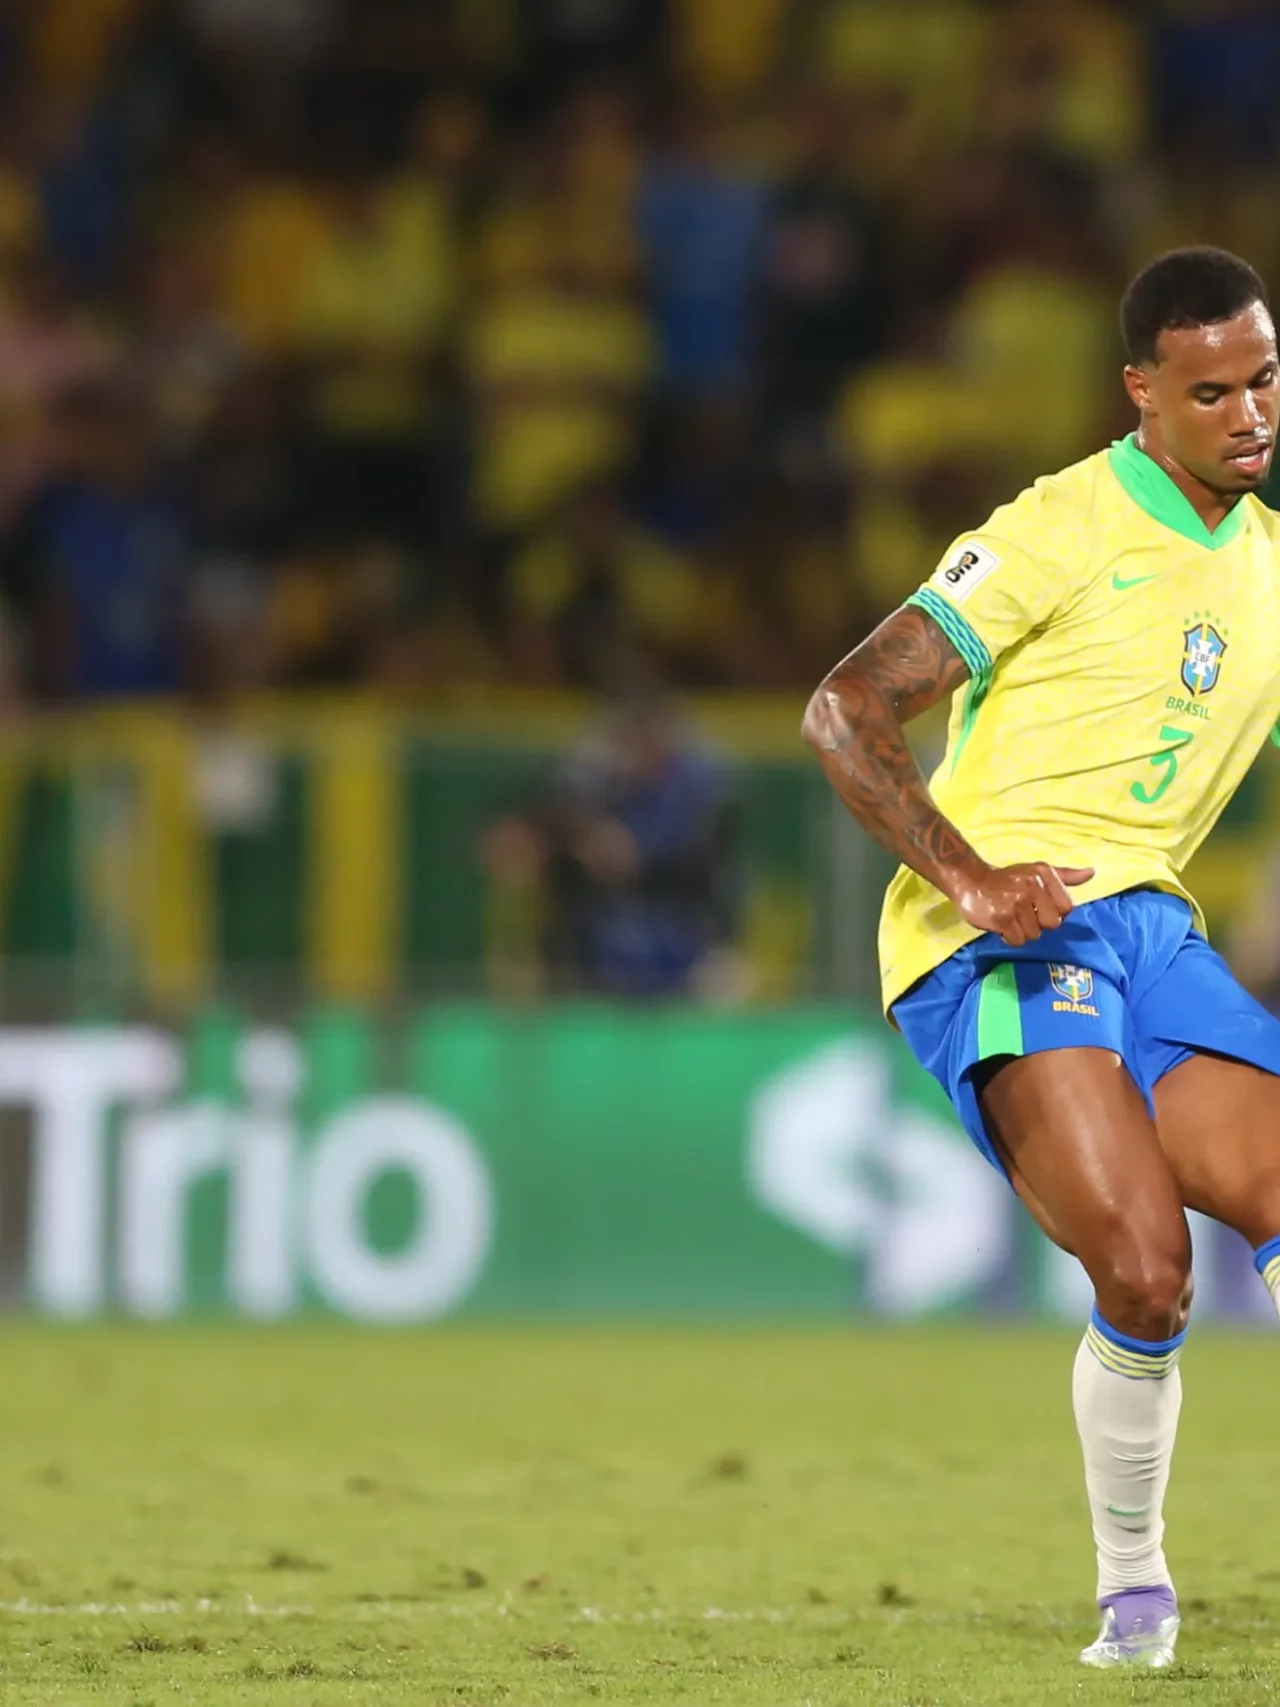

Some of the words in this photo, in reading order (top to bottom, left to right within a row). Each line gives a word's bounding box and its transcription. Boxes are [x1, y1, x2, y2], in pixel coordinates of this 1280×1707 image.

[1194, 651, 1211, 663] CBF
[1166, 695, 1211, 721] BRASIL
[1130, 724, 1194, 804] 3
[1052, 1000, 1100, 1017] BRASIL
[0, 1029, 495, 1325] Trio
